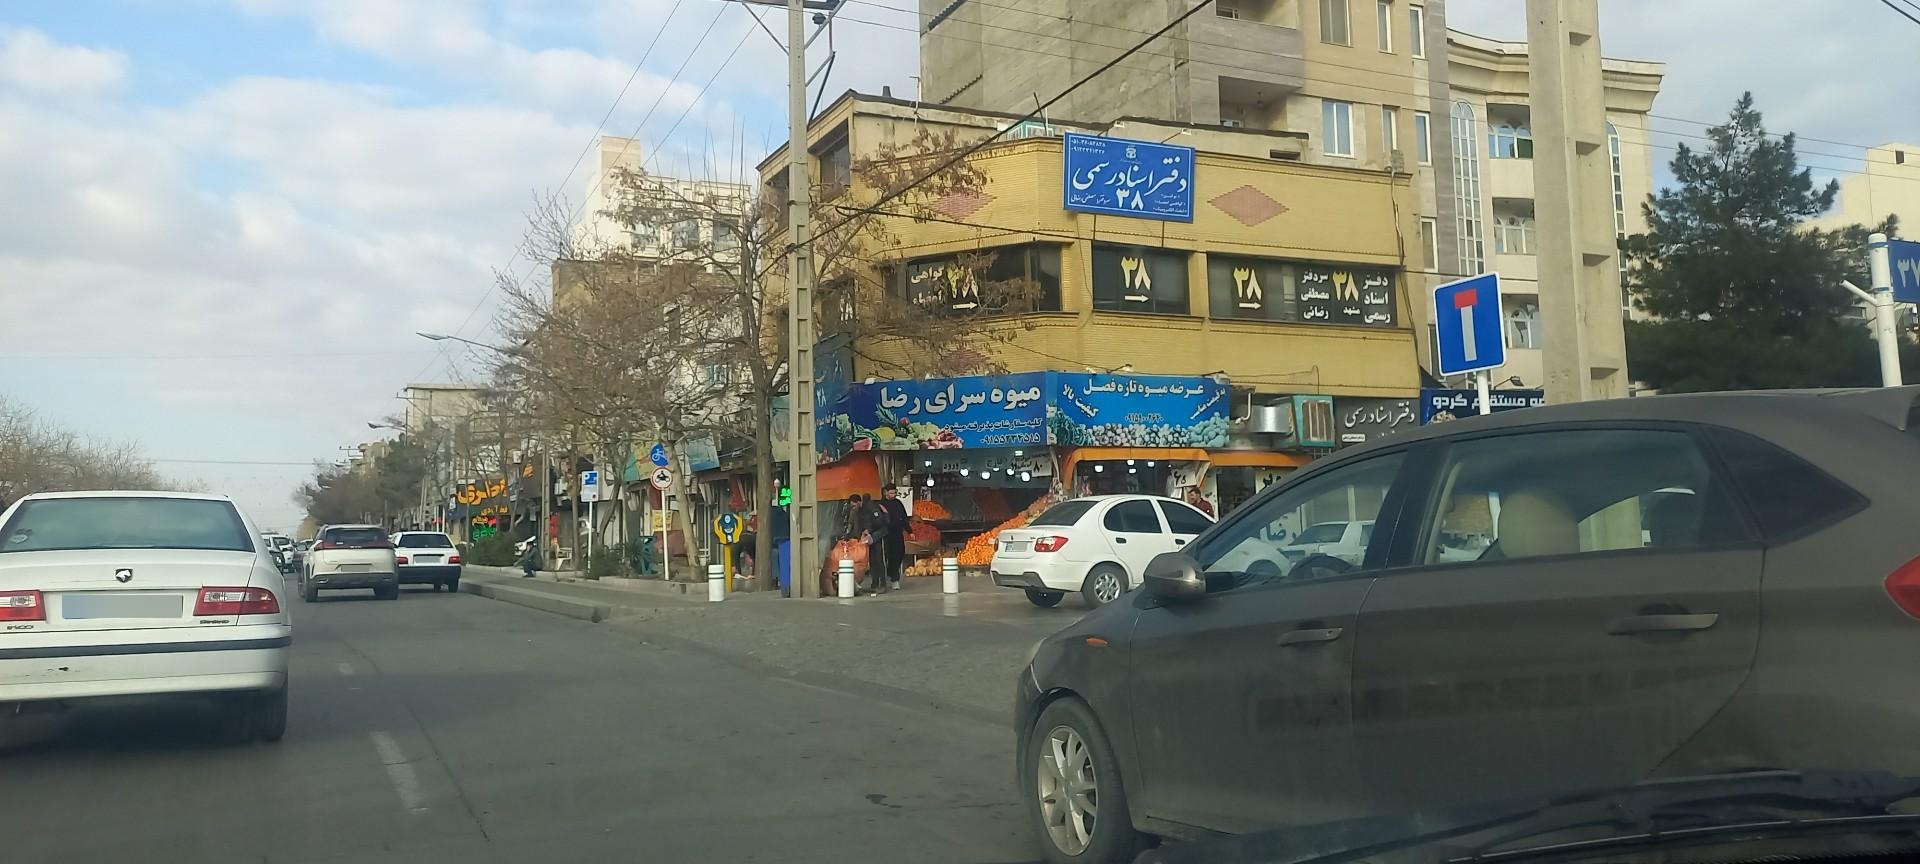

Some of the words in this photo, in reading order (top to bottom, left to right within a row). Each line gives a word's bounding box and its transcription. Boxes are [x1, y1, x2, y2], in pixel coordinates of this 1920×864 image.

[1072, 160, 1117, 190] رسمی
[1116, 164, 1154, 188] اسناد
[1144, 156, 1187, 196] دفتر
[1116, 188, 1144, 210] ۳۸
[1121, 256, 1151, 291] ۳۸
[1301, 271, 1329, 284] سردفتر
[1363, 272, 1389, 290] دفتر
[1233, 267, 1262, 301] ۳۸
[1332, 271, 1359, 302] ۳۸
[1300, 288, 1330, 301] مصطفی
[1363, 291, 1389, 305] اسناد
[1343, 305, 1361, 315] مشهد
[1364, 311, 1391, 324] رسمی
[1063, 384, 1075, 402] بالا
[1083, 378, 1115, 395] فصل
[1117, 379, 1136, 397] تازه
[1138, 384, 1168, 398] میوه
[1170, 384, 1204, 399] عرضه
[880, 386, 921, 415] رضا
[924, 383, 986, 414] سرای
[991, 385, 1041, 410] میوه
[1433, 393, 1468, 409] گردو
[1075, 397, 1099, 418] کیفیت
[1369, 406, 1392, 423] اسناد
[1389, 401, 1415, 427] دفتر
[1027, 417, 1043, 429] کلیه
[1344, 407, 1367, 428] رسمی
[583, 473, 590, 484] P
